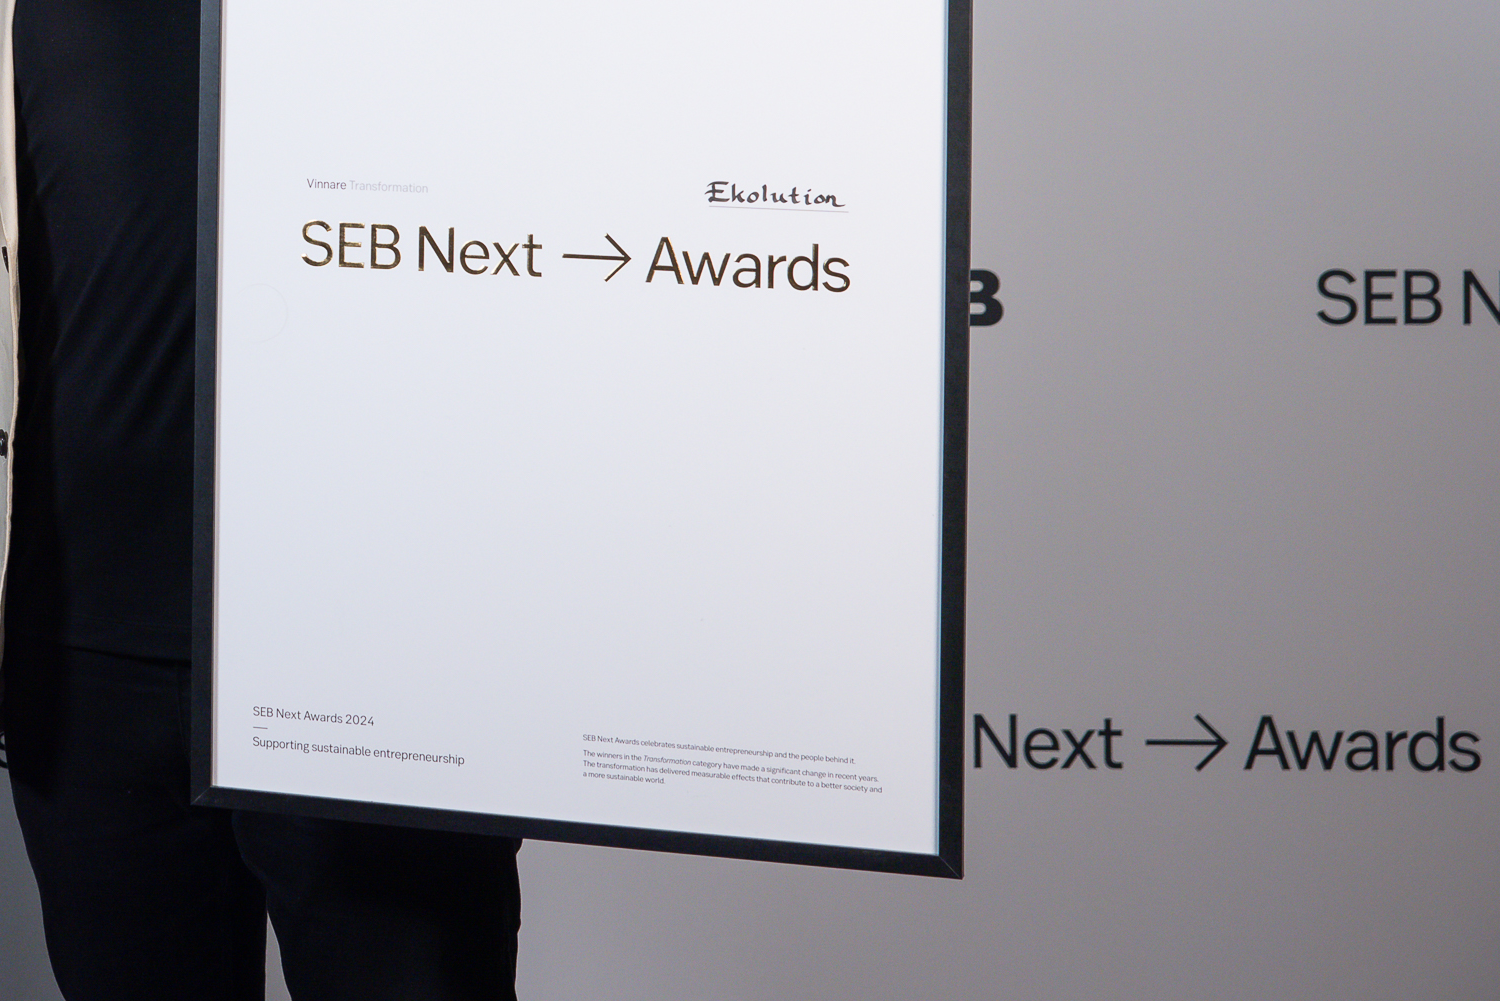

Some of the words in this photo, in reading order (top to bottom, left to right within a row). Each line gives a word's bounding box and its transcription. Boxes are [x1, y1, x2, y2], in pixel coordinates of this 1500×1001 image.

[306, 178, 347, 190] Vinnare
[349, 180, 428, 193] Transformation
[704, 180, 846, 208] Ekolution
[302, 221, 400, 269] SEB
[419, 227, 542, 277] Next
[646, 237, 850, 292] Awards
[1318, 270, 1442, 325] SEB
[253, 706, 273, 717] SEB
[276, 708, 301, 720] Next
[304, 711, 342, 723] Awards
[346, 714, 373, 726] 2024
[253, 737, 309, 753] Supporting
[312, 744, 371, 756] sustainable
[374, 750, 464, 766] entrepreneurship
[582, 734, 596, 742] SEB
[597, 735, 614, 744] Next
[614, 737, 640, 746] Awards
[640, 739, 676, 749] celebrates
[715, 746, 774, 758] entrepreneurship
[774, 750, 788, 759] and
[788, 751, 800, 760] the
[800, 753, 824, 763] people
[825, 755, 848, 764] behind
[974, 714, 1122, 769] Next
[1245, 716, 1481, 772] Awards
[583, 749, 596, 758] The
[596, 751, 623, 760] winners
[623, 752, 630, 761] in
[631, 753, 642, 762] the
[643, 755, 692, 766] Transformation
[692, 759, 722, 769] category
[722, 762, 740, 770] have
[740, 763, 760, 772] made
[801, 769, 826, 779] change
[827, 770, 834, 778] in
[835, 771, 857, 780] recent
[583, 759, 596, 768] The
[596, 761, 645, 772] transformation
[646, 765, 659, 774] has
[659, 767, 690, 776] delivered
[691, 770, 731, 780] measurable
[731, 773, 756, 782] effects
[756, 775, 770, 783] that
[771, 777, 806, 787] contribute
[807, 779, 815, 787] to
[821, 781, 842, 790] better
[843, 783, 868, 794] society
[869, 784, 883, 793] and
